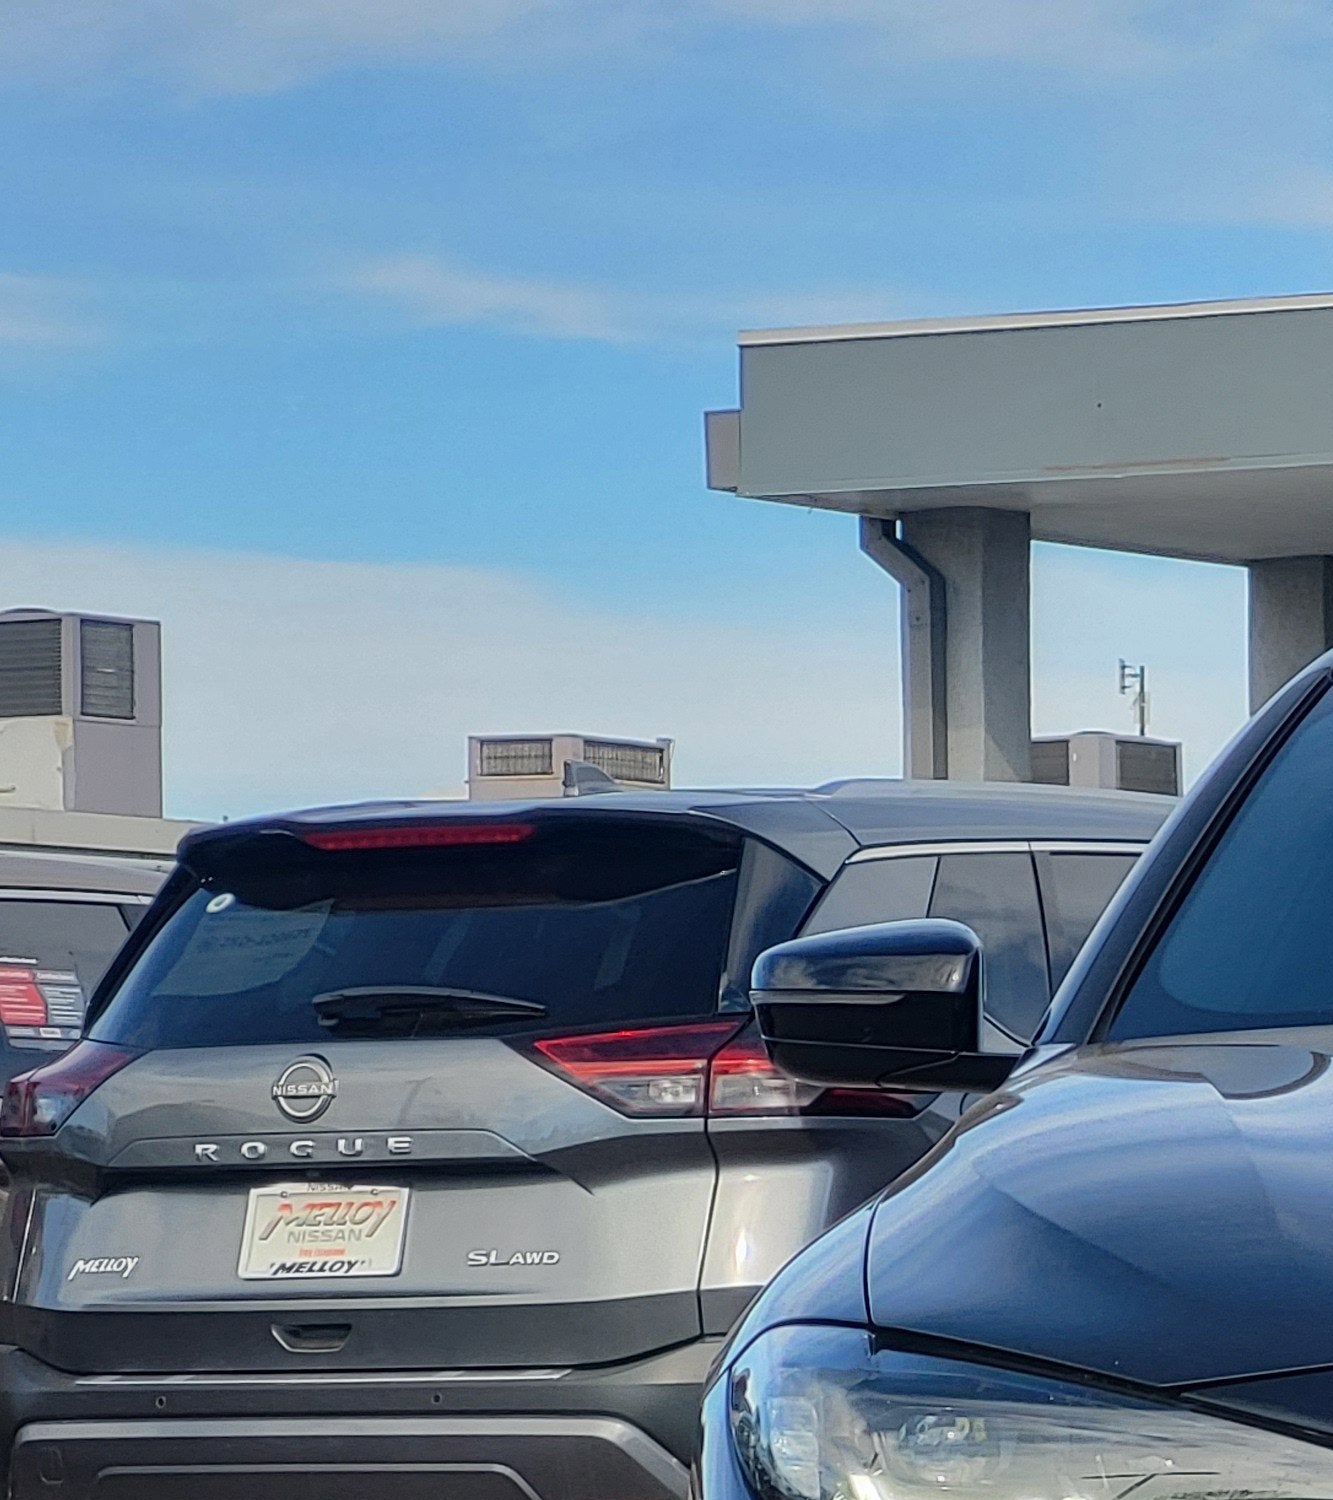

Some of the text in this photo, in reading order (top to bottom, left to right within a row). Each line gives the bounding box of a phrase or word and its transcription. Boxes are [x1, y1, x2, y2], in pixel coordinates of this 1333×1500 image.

[272, 1082, 333, 1096] NISSAN
[194, 1136, 414, 1162] ROGUE
[258, 1199, 397, 1240] MELLOY
[287, 1229, 363, 1244] NISSAN
[67, 1256, 139, 1280] MELLOY
[272, 1260, 358, 1276] MELLOY
